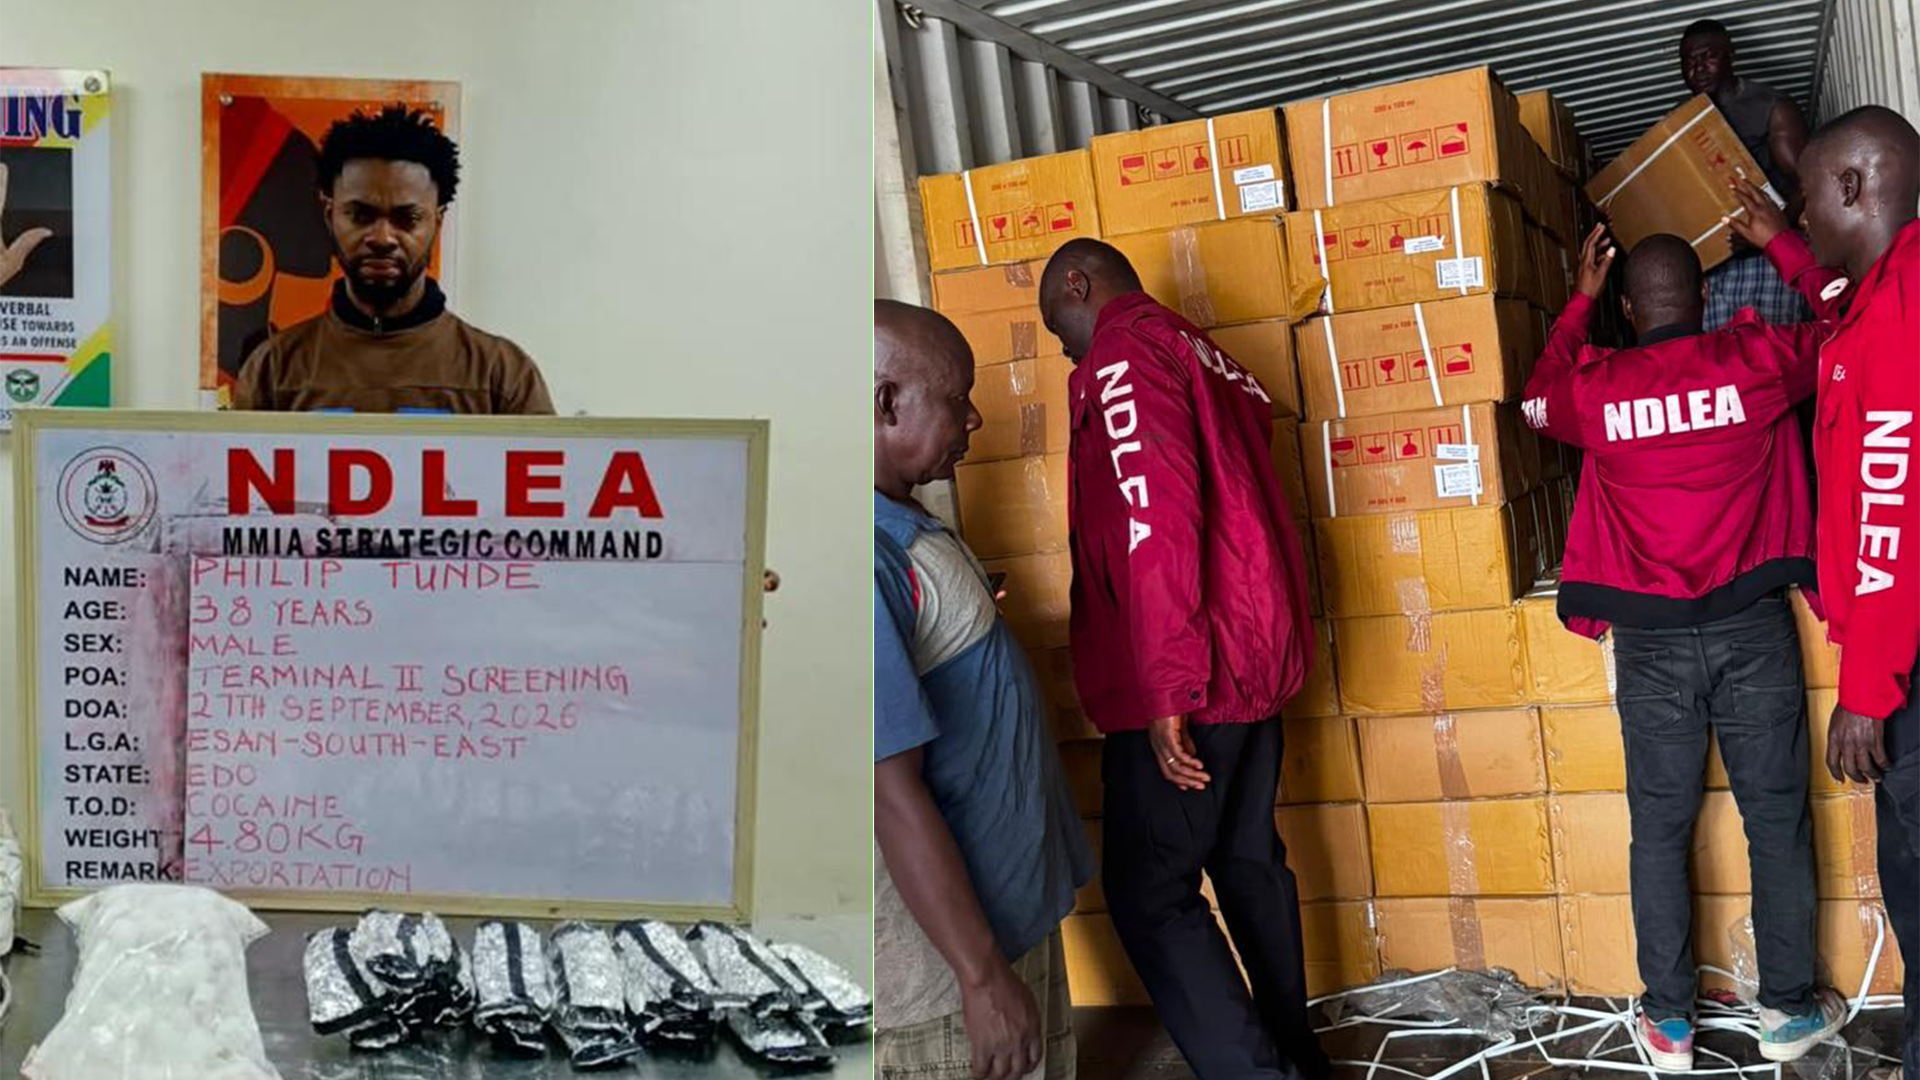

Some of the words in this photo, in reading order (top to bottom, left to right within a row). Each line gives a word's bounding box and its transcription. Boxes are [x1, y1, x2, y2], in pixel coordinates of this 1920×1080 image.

[0, 301, 51, 316] VERBAL
[0, 318, 17, 332] SE
[22, 320, 75, 333] TOWARDS
[12, 336, 27, 347] AN
[31, 336, 77, 349] OFFENSE
[1604, 384, 1747, 442] NDLEA
[1096, 360, 1152, 556] NDLEA
[228, 448, 664, 518] NDLEA
[1855, 411, 1913, 596] NDLEA
[222, 527, 304, 556] MMIA
[316, 528, 493, 558] STRATEGIC
[504, 529, 663, 559] COMMAND
[64, 567, 146, 588] NAME:
[193, 557, 343, 589] PHILIP
[382, 561, 540, 592] TUNDE
[64, 600, 126, 620] AGE:
[192, 595, 252, 626] 38
[273, 599, 373, 627] YEARS
[64, 633, 122, 653] SEX:
[191, 633, 297, 657] MALE
[65, 667, 126, 686] POA:
[193, 664, 384, 689] TERMINAL
[442, 664, 629, 696] SCREENING
[65, 699, 127, 719] DOA:
[191, 692, 266, 719] 27TH
[65, 732, 139, 751] L.G.A:
[65, 764, 150, 784] STATE:
[187, 764, 256, 788] EDO
[65, 796, 136, 816] T.O.D:
[187, 792, 343, 818] COCAINE
[66, 860, 181, 882] REMARK:
[186, 857, 411, 892] EXPORTATION
